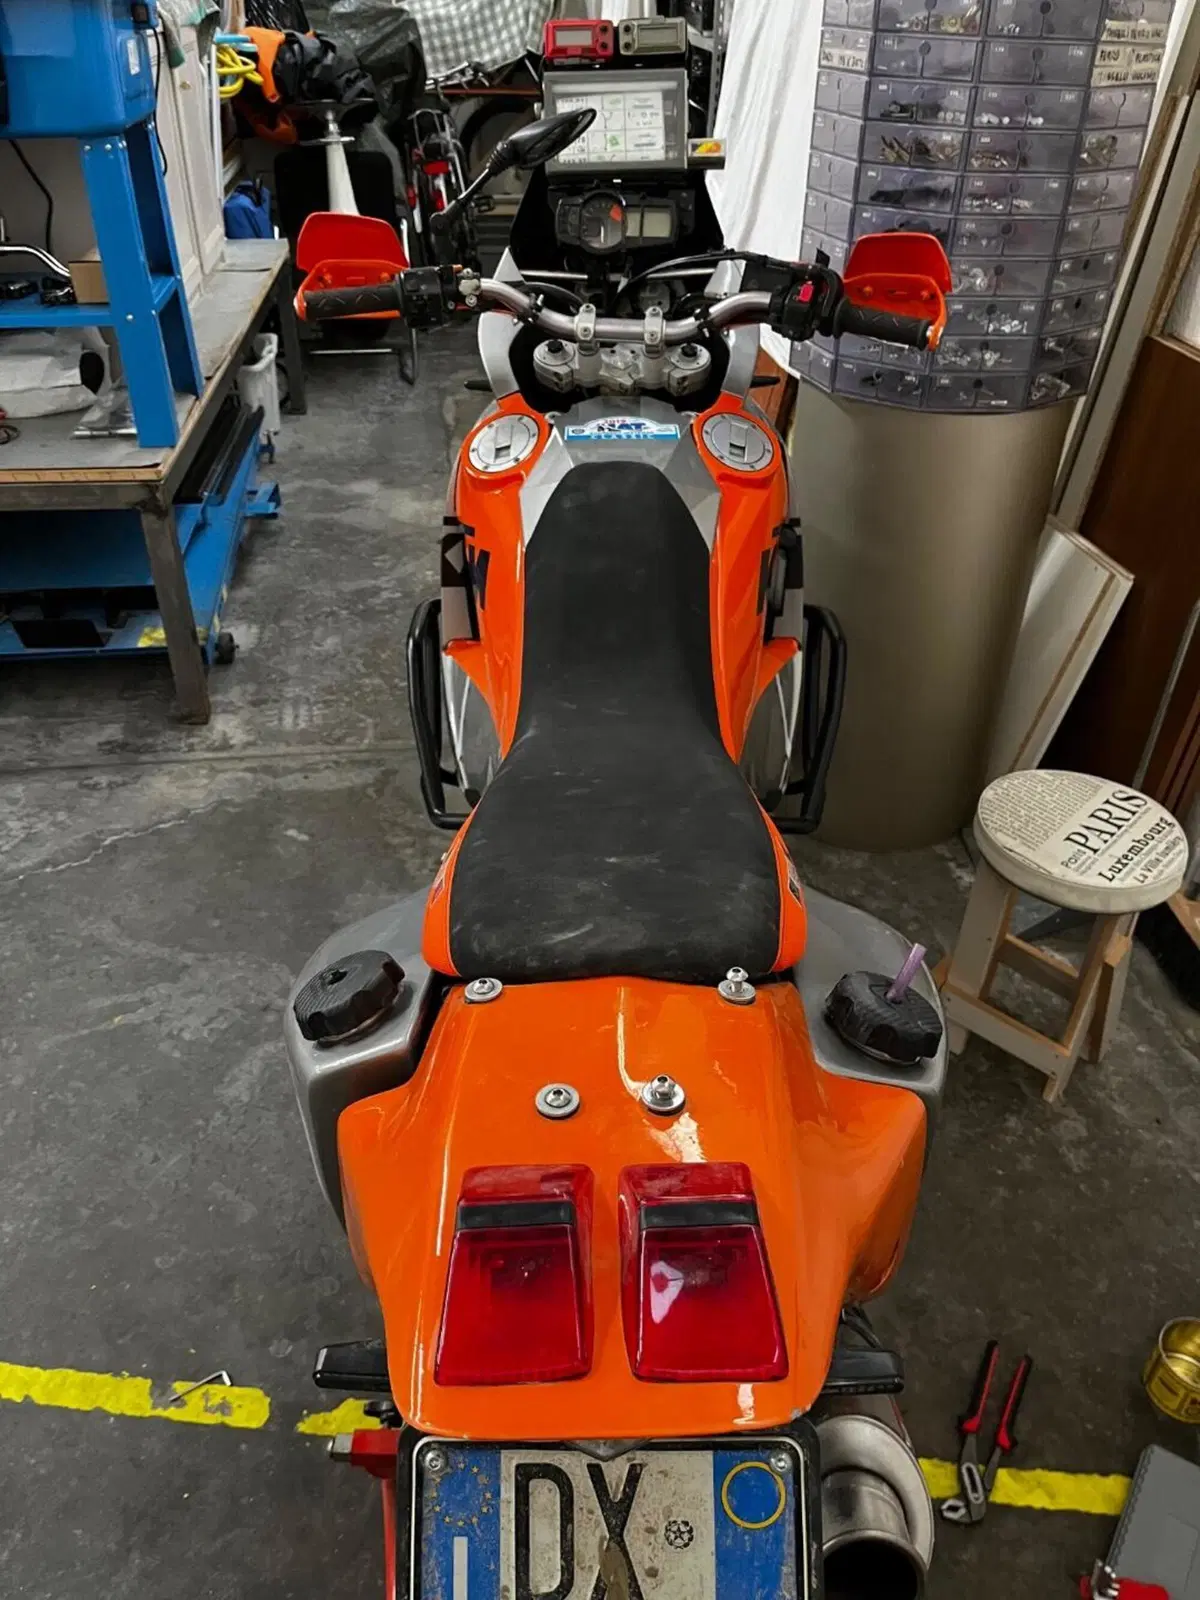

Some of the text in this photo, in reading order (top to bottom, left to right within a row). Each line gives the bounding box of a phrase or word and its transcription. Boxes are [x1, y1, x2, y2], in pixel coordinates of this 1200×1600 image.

[1063, 789, 1148, 854] PARIS
[1097, 816, 1175, 882] Luxembourg
[515, 1462, 645, 1600] DX
